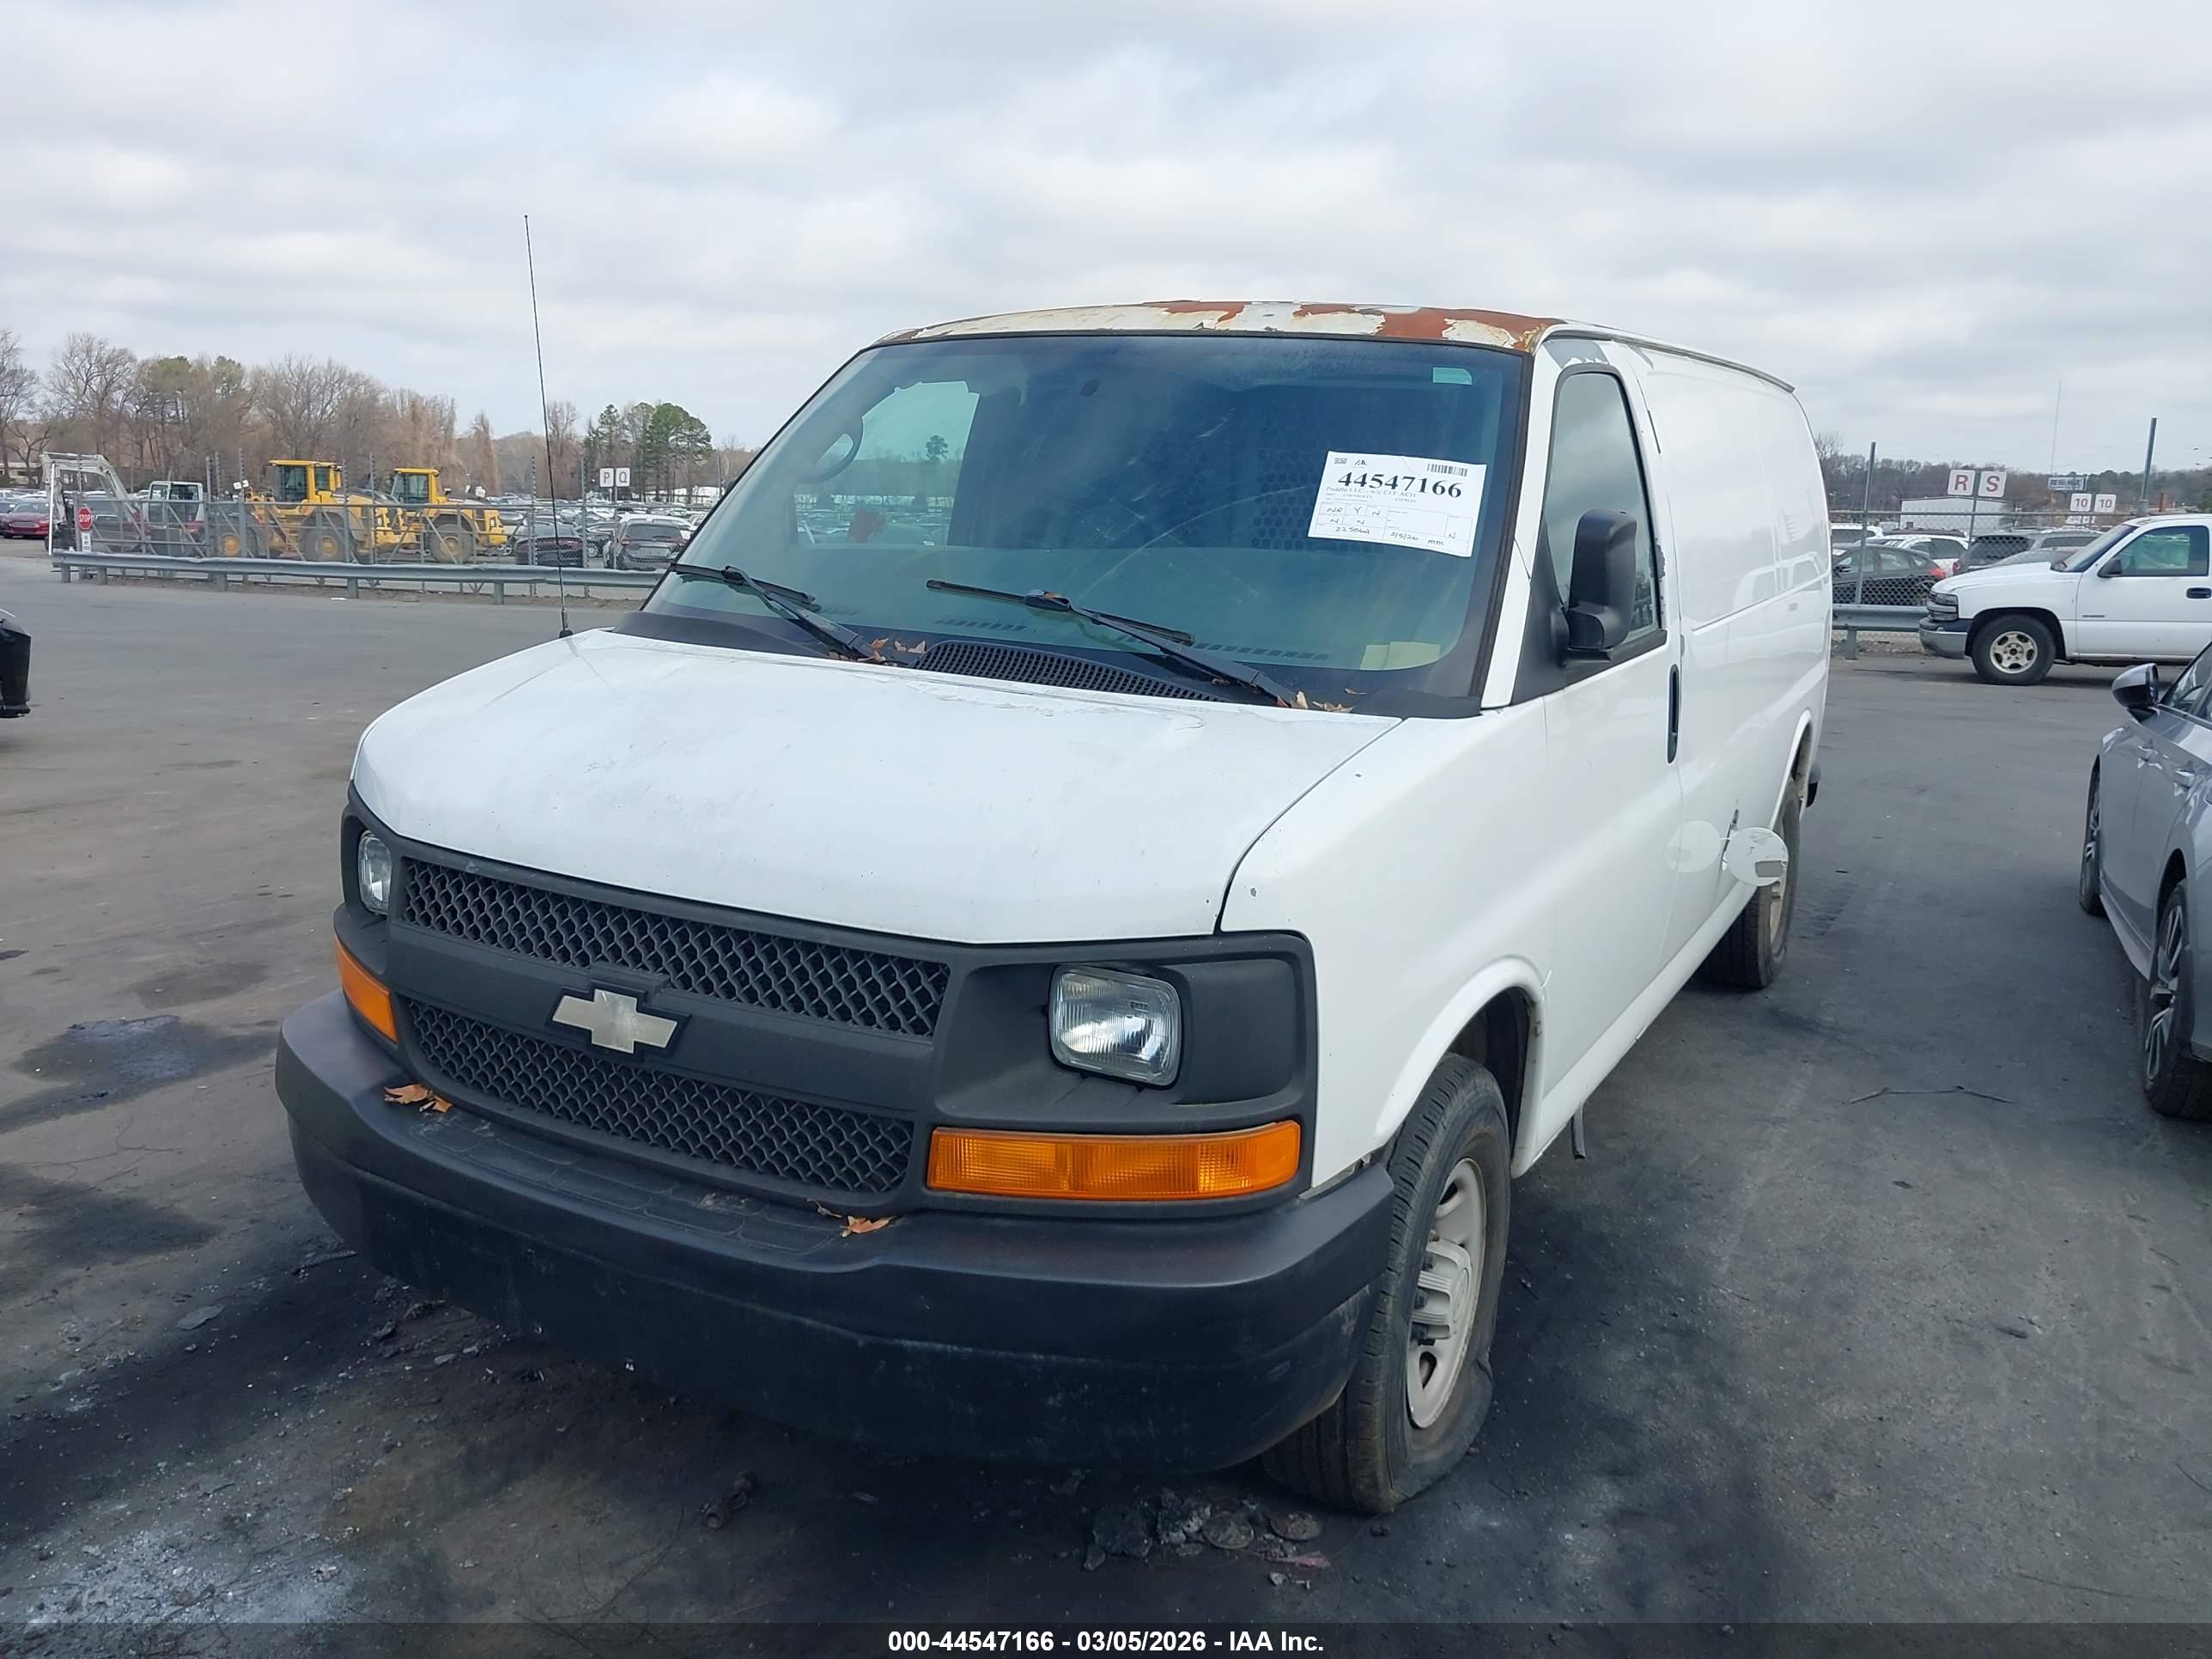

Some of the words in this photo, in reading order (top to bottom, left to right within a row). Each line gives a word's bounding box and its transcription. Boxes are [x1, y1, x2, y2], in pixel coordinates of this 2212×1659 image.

[605, 471, 611, 483] P
[618, 471, 628, 483] Q
[1954, 474, 1969, 491] R
[1337, 471, 1463, 498] 44547166
[1985, 475, 2001, 492] S
[2075, 498, 2088, 507] 10
[2099, 499, 2112, 508] 10
